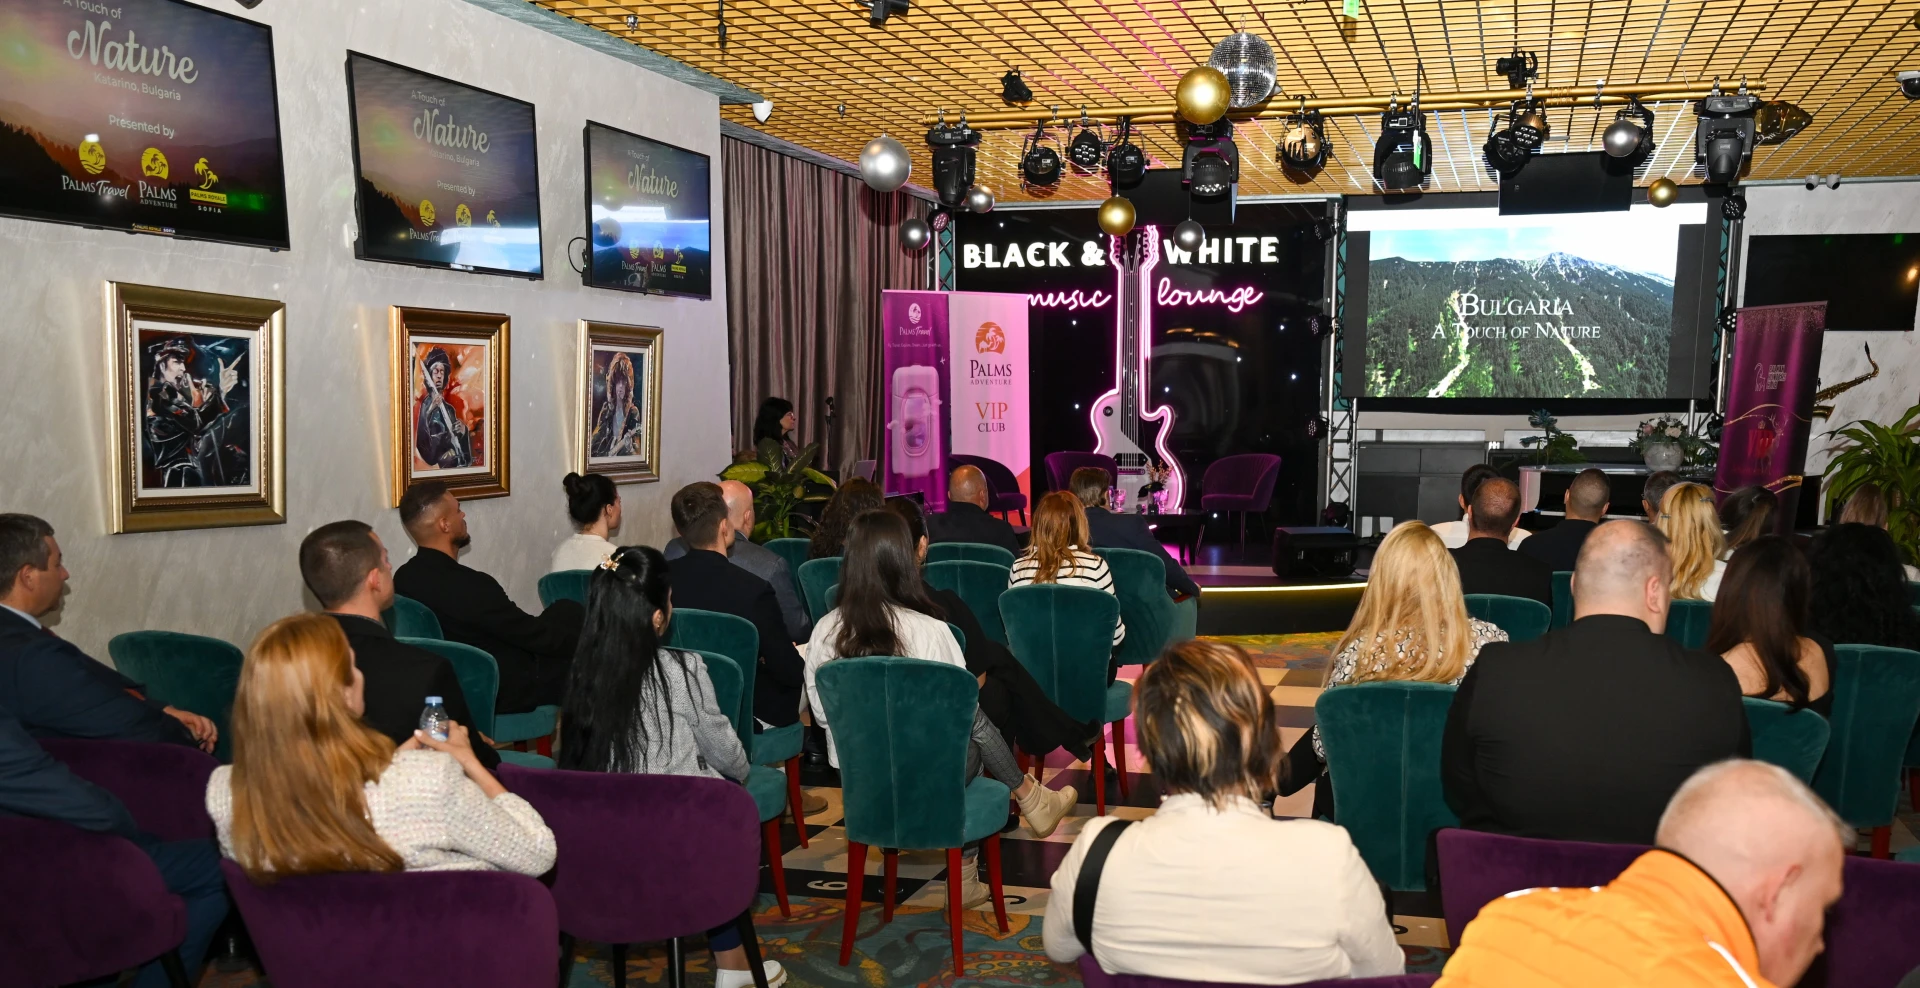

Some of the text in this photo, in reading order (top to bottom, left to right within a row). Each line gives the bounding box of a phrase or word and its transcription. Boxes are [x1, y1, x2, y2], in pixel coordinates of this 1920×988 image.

[111, 8, 122, 19] of
[67, 19, 199, 84] Nature
[94, 72, 181, 101] Katarino, Bulgaria
[417, 91, 438, 104] Touch
[108, 115, 175, 139] Presented by
[413, 108, 491, 153] Nature
[61, 175, 131, 199] PALMS Travel
[138, 180, 177, 201] PALMS
[437, 180, 476, 197] Presented by
[628, 163, 679, 198] Nature
[140, 199, 178, 209] ADVENTURE
[197, 205, 222, 214] SOFIA
[409, 228, 429, 241] PALMS
[963, 236, 1279, 269] BLACK & WHITE
[1027, 276, 1264, 313] music lounge
[1461, 293, 1575, 316] BULGARIA
[1431, 322, 1601, 339] A TOUCH OF NATURE
[970, 359, 1012, 379] PALMS
[975, 402, 1009, 420] VIP
[977, 422, 1006, 433] CLUB
